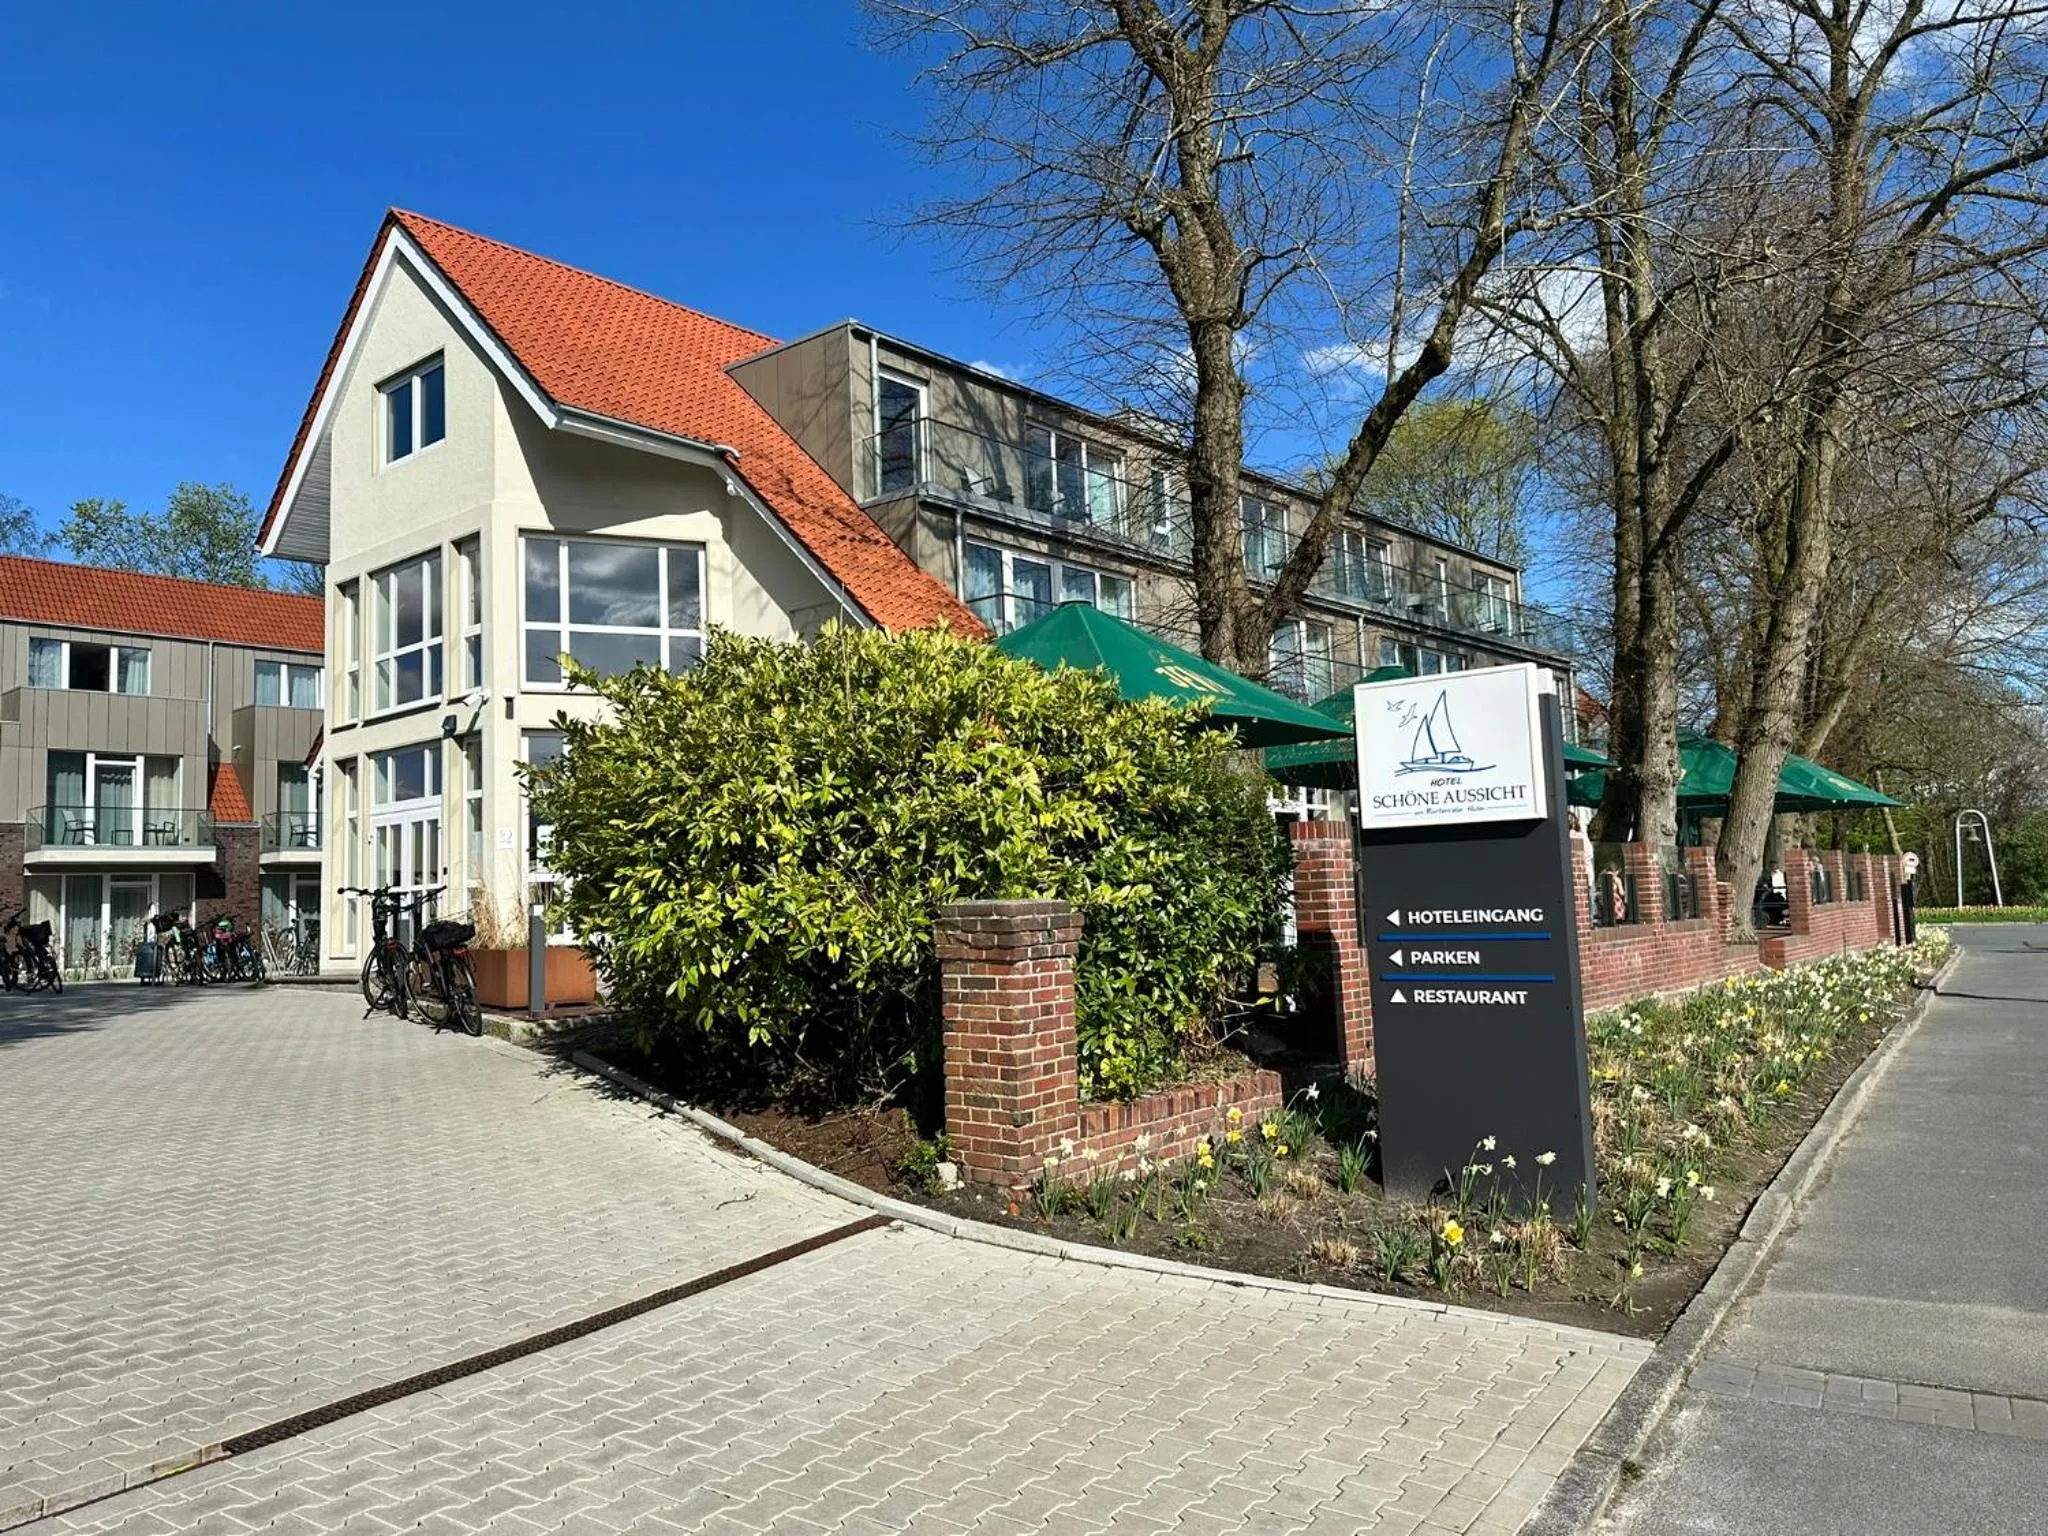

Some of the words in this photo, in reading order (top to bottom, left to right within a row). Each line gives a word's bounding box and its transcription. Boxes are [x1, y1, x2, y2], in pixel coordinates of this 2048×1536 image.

[1430, 777, 1463, 787] HOTEL
[1373, 790, 1440, 809] SCHÖNE
[1443, 785, 1527, 804] AUSSICHT
[1408, 908, 1544, 924] HOTELEINGANG
[1411, 951, 1480, 964] PARKEN
[1413, 990, 1528, 1004] RESTAURANT
